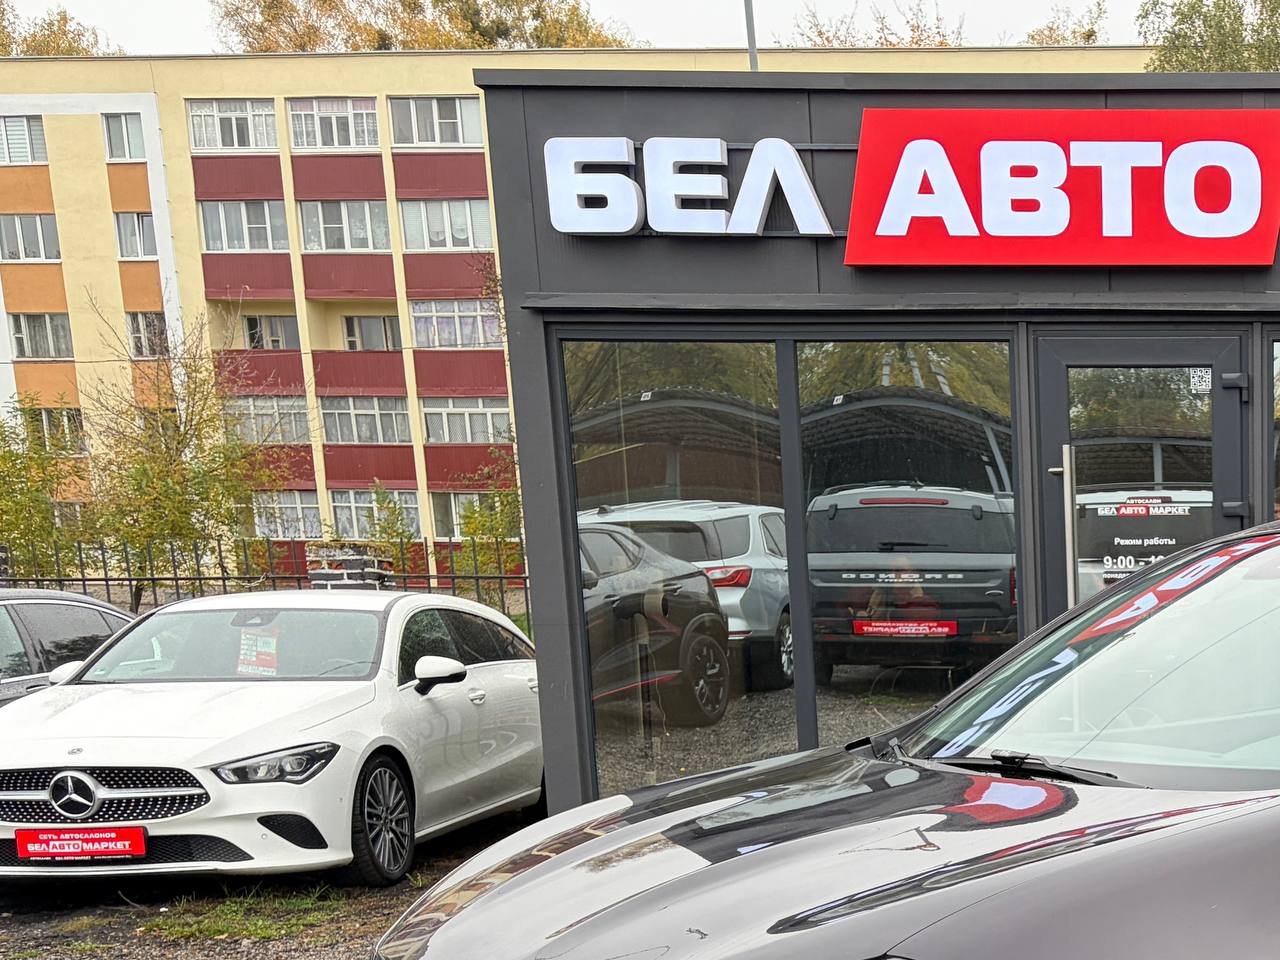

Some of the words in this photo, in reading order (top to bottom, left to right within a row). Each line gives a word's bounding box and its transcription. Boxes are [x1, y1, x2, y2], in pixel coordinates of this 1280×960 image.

[543, 136, 836, 238] БЕЛ
[875, 138, 1263, 239] АВТО
[1097, 506, 1117, 515] БЕЛ
[1120, 506, 1147, 515] АВТО
[1149, 506, 1191, 515] МАРКЕТ
[1114, 537, 1142, 545] Режим
[1144, 536, 1176, 547] работы
[1103, 555, 1135, 569] 9:00
[60, 832, 117, 840] АВТОСАЛОНОВ
[27, 843, 48, 851] БЕЛ
[51, 841, 80, 851] АВТО
[83, 841, 131, 850] МАРКЕТ
